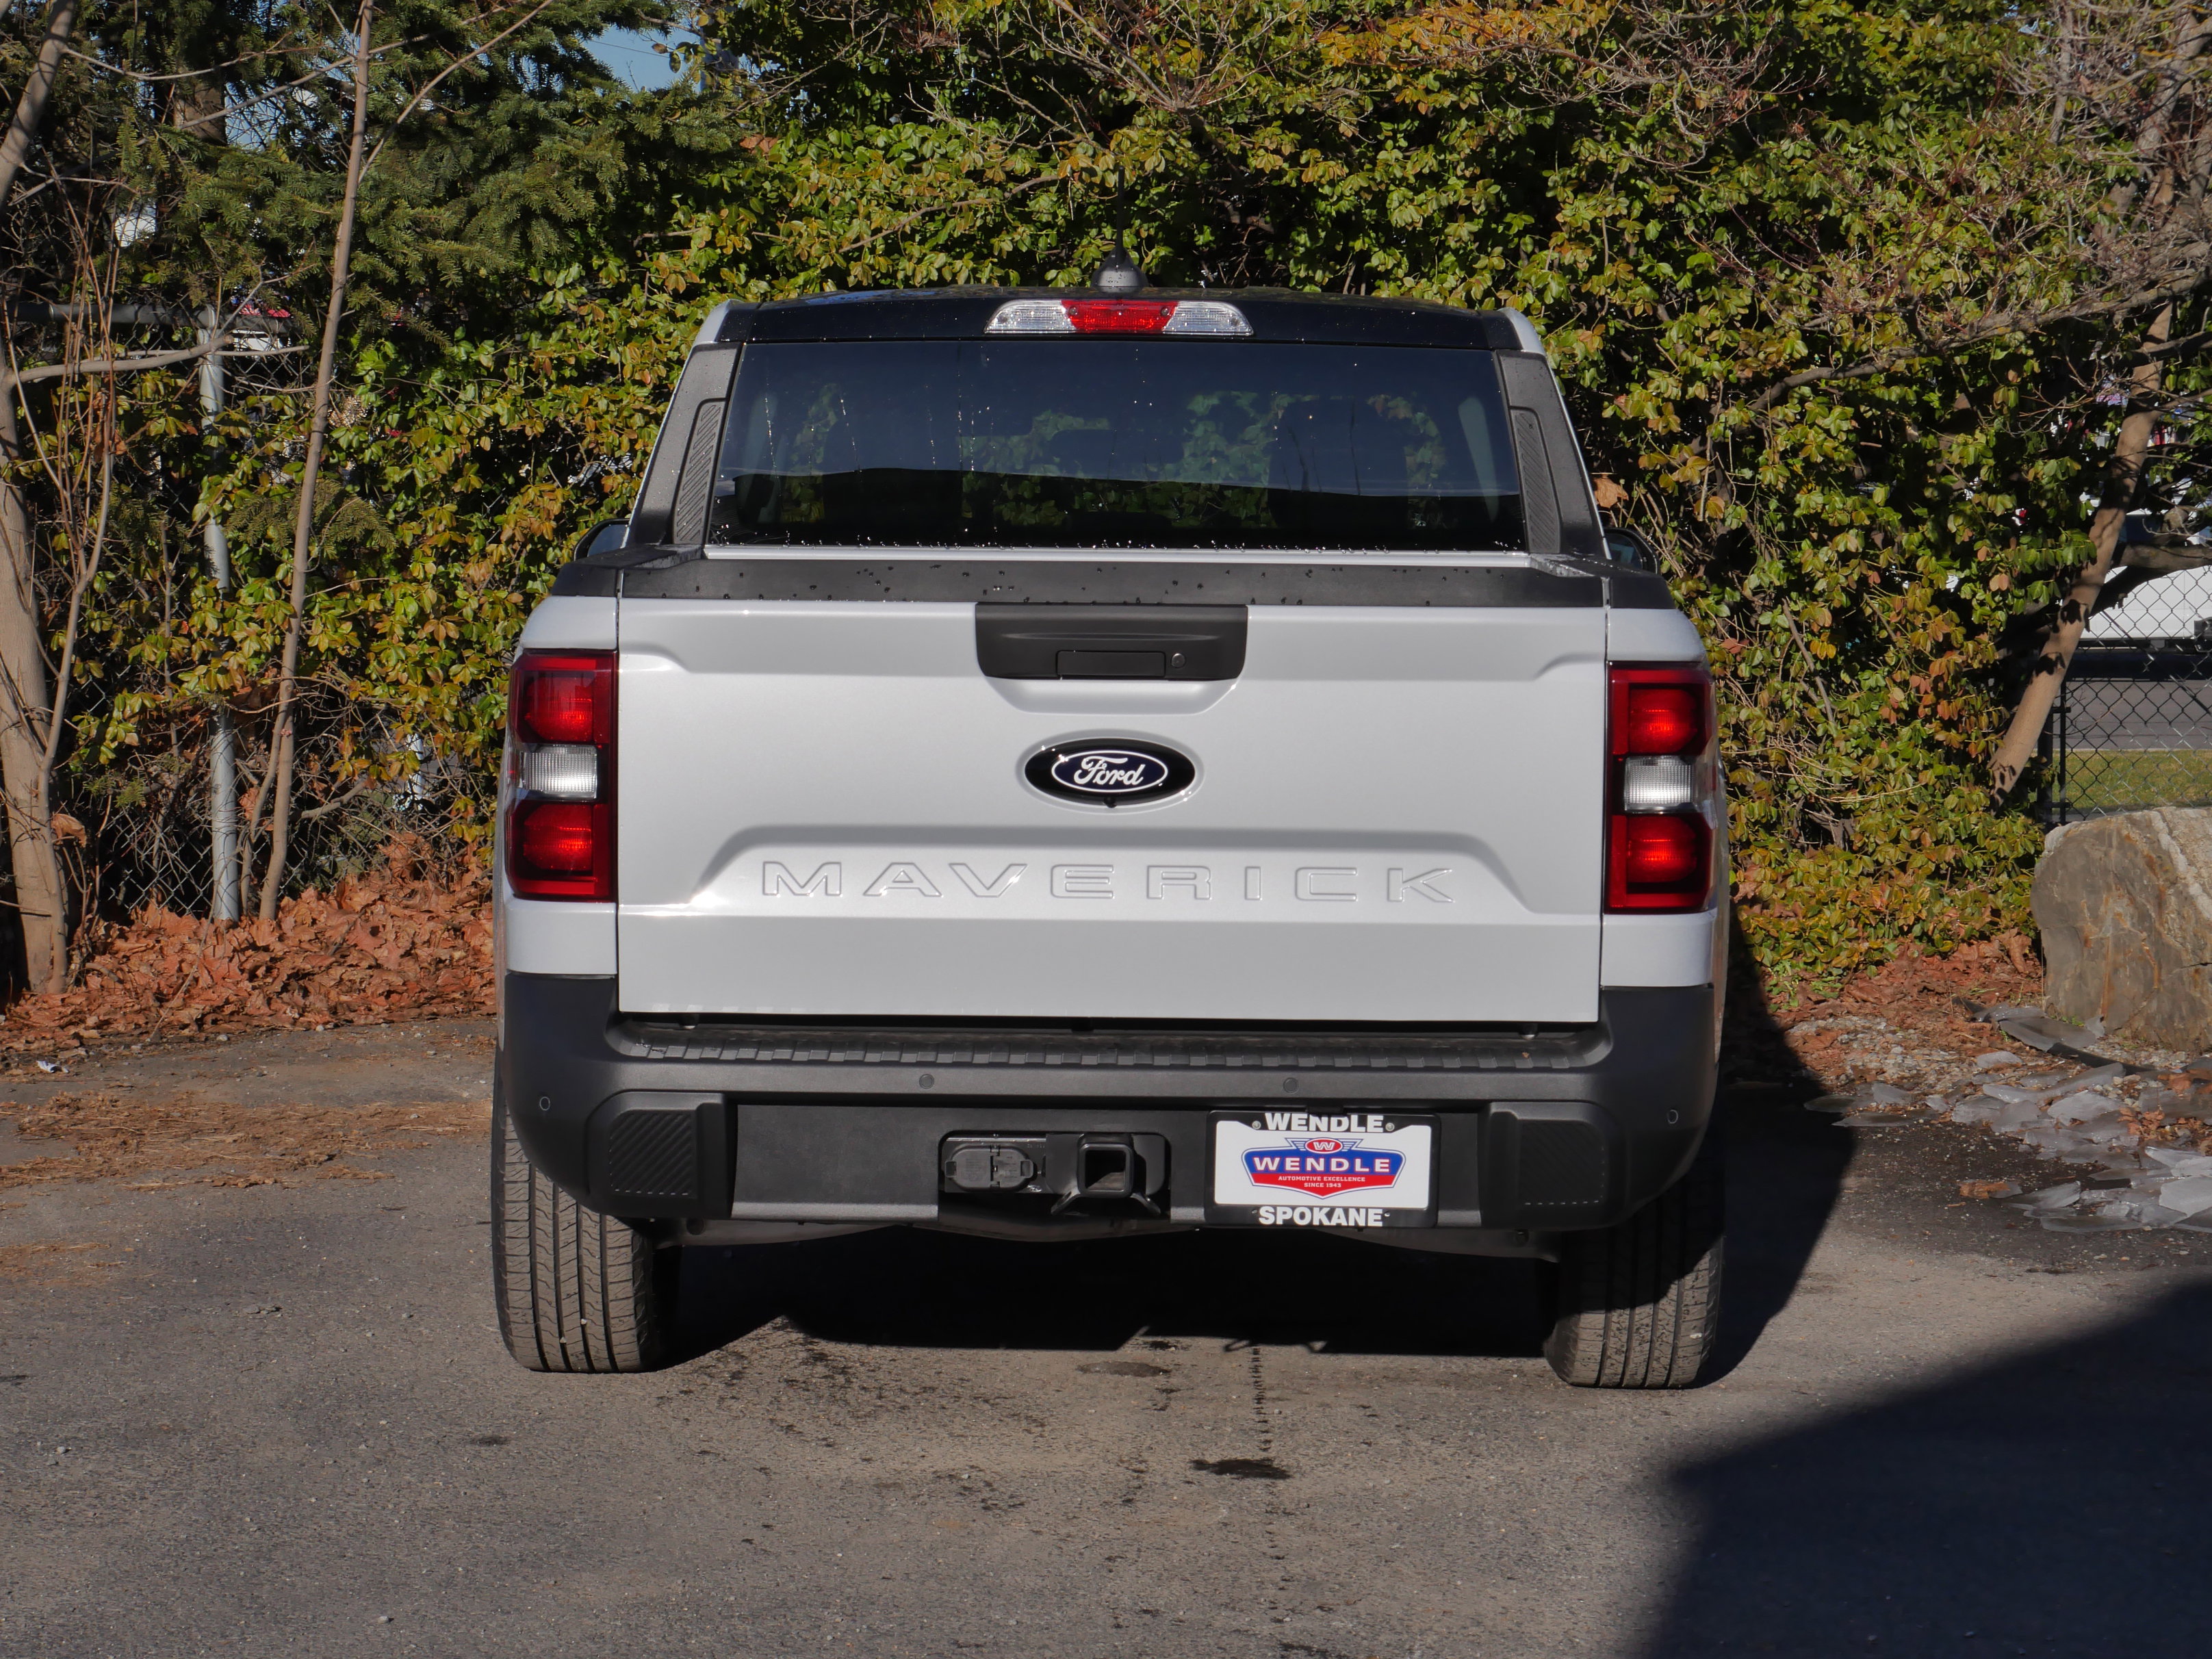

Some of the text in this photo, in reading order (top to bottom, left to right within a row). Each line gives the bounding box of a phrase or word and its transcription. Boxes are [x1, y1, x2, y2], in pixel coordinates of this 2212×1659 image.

[1073, 755, 1146, 786] Ford
[762, 860, 1456, 903] MAVERICK
[1265, 1113, 1384, 1133] WENDLE
[1313, 1141, 1335, 1151] W
[1253, 1157, 1390, 1172] WENDLE
[1259, 1206, 1383, 1227] SPOKANE
